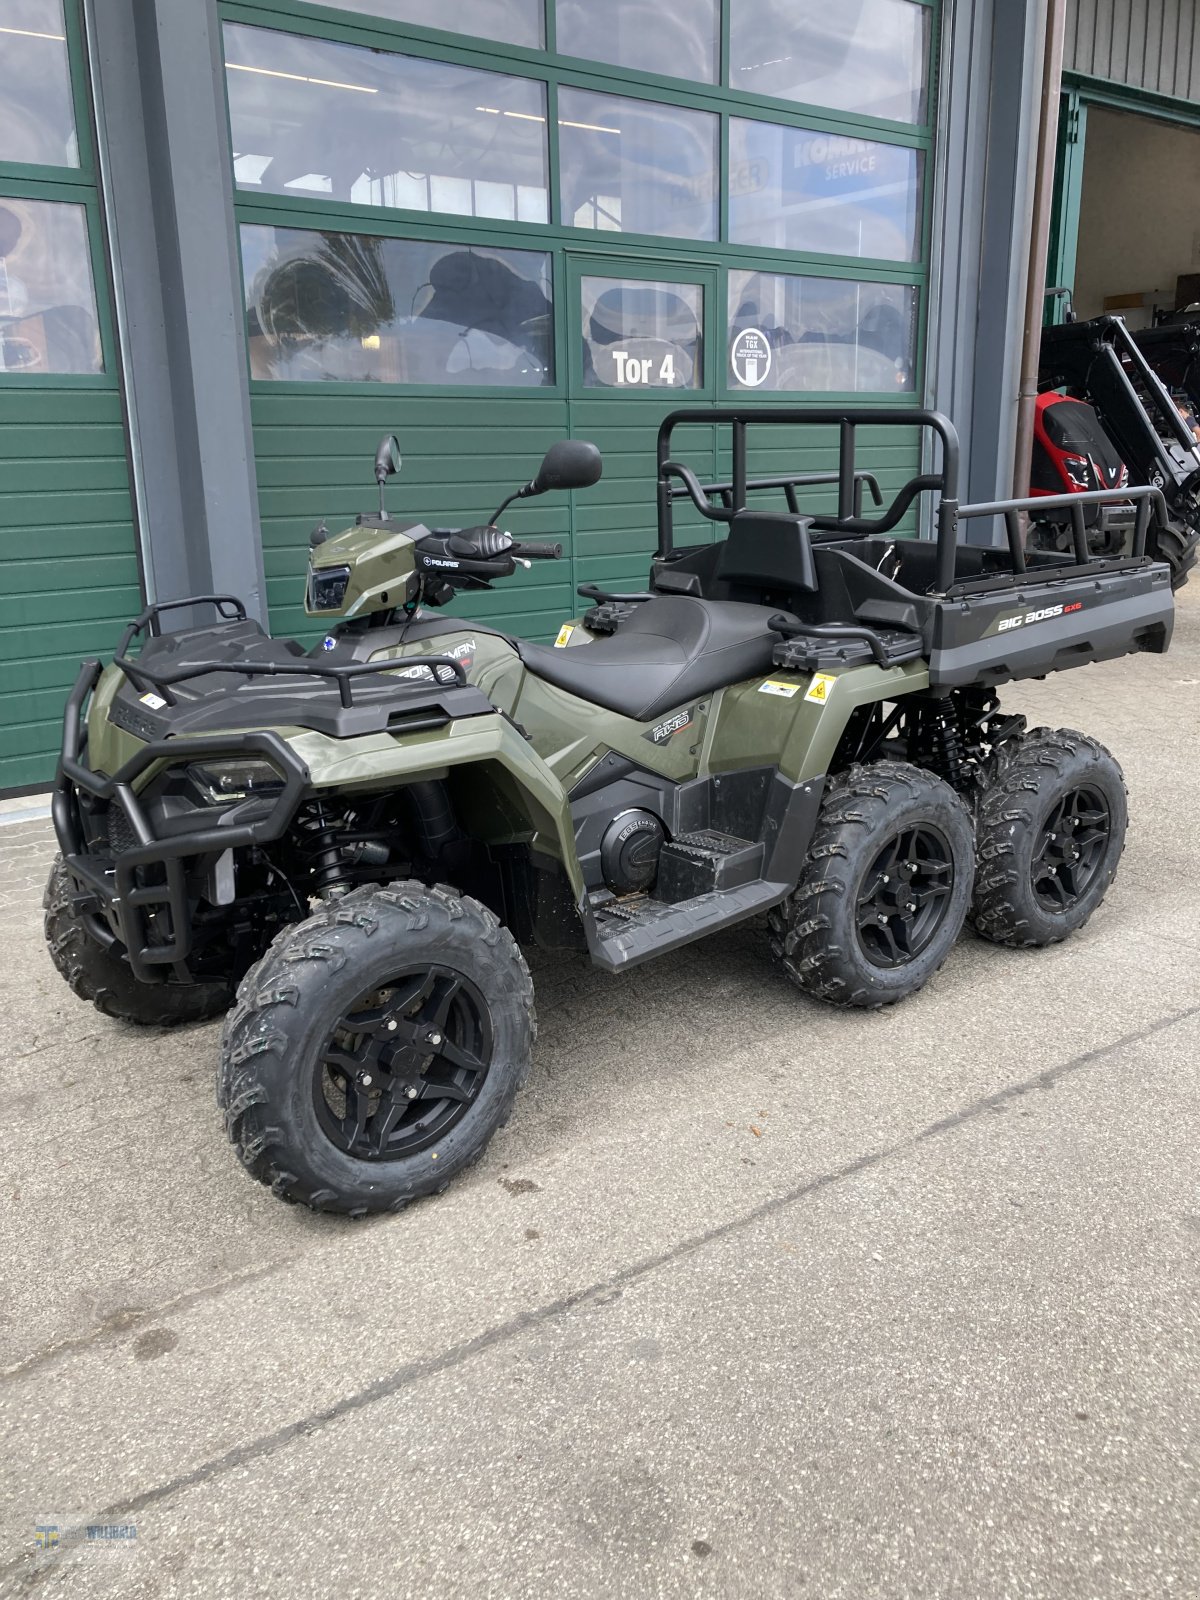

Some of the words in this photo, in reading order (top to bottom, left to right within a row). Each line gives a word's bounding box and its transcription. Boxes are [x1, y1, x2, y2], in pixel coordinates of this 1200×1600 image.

[825, 156, 876, 180] SERVICE
[745, 340, 758, 349] TGX
[612, 351, 652, 384] Tor
[659, 354, 675, 385] 4
[431, 559, 460, 568] POLARIS
[998, 615, 1023, 631] BIG
[1025, 604, 1064, 624] BOSS
[653, 714, 690, 742] AWD
